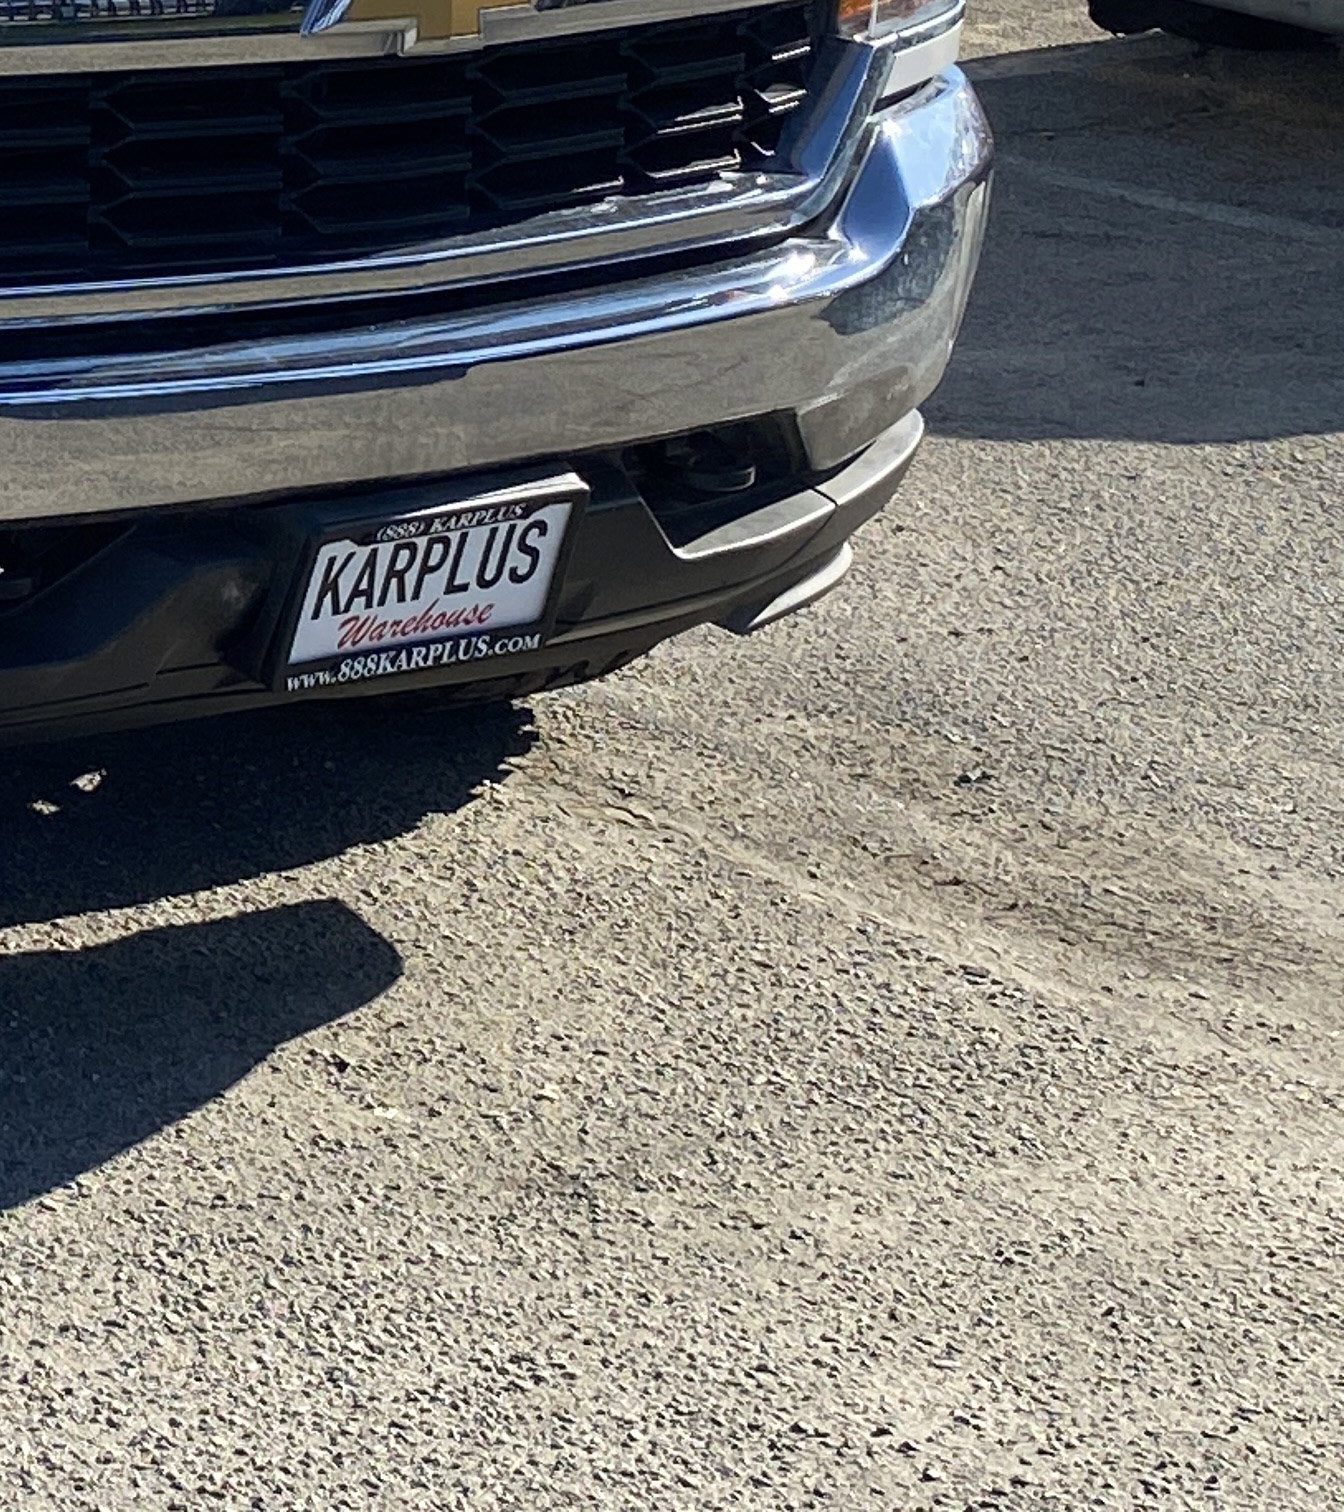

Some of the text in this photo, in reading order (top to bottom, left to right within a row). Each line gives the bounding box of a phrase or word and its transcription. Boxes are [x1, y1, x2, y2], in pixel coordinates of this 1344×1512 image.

[376, 502, 527, 542] (888) KARPLUS
[310, 518, 549, 621] KARPLUS
[336, 597, 496, 650] Warehouse
